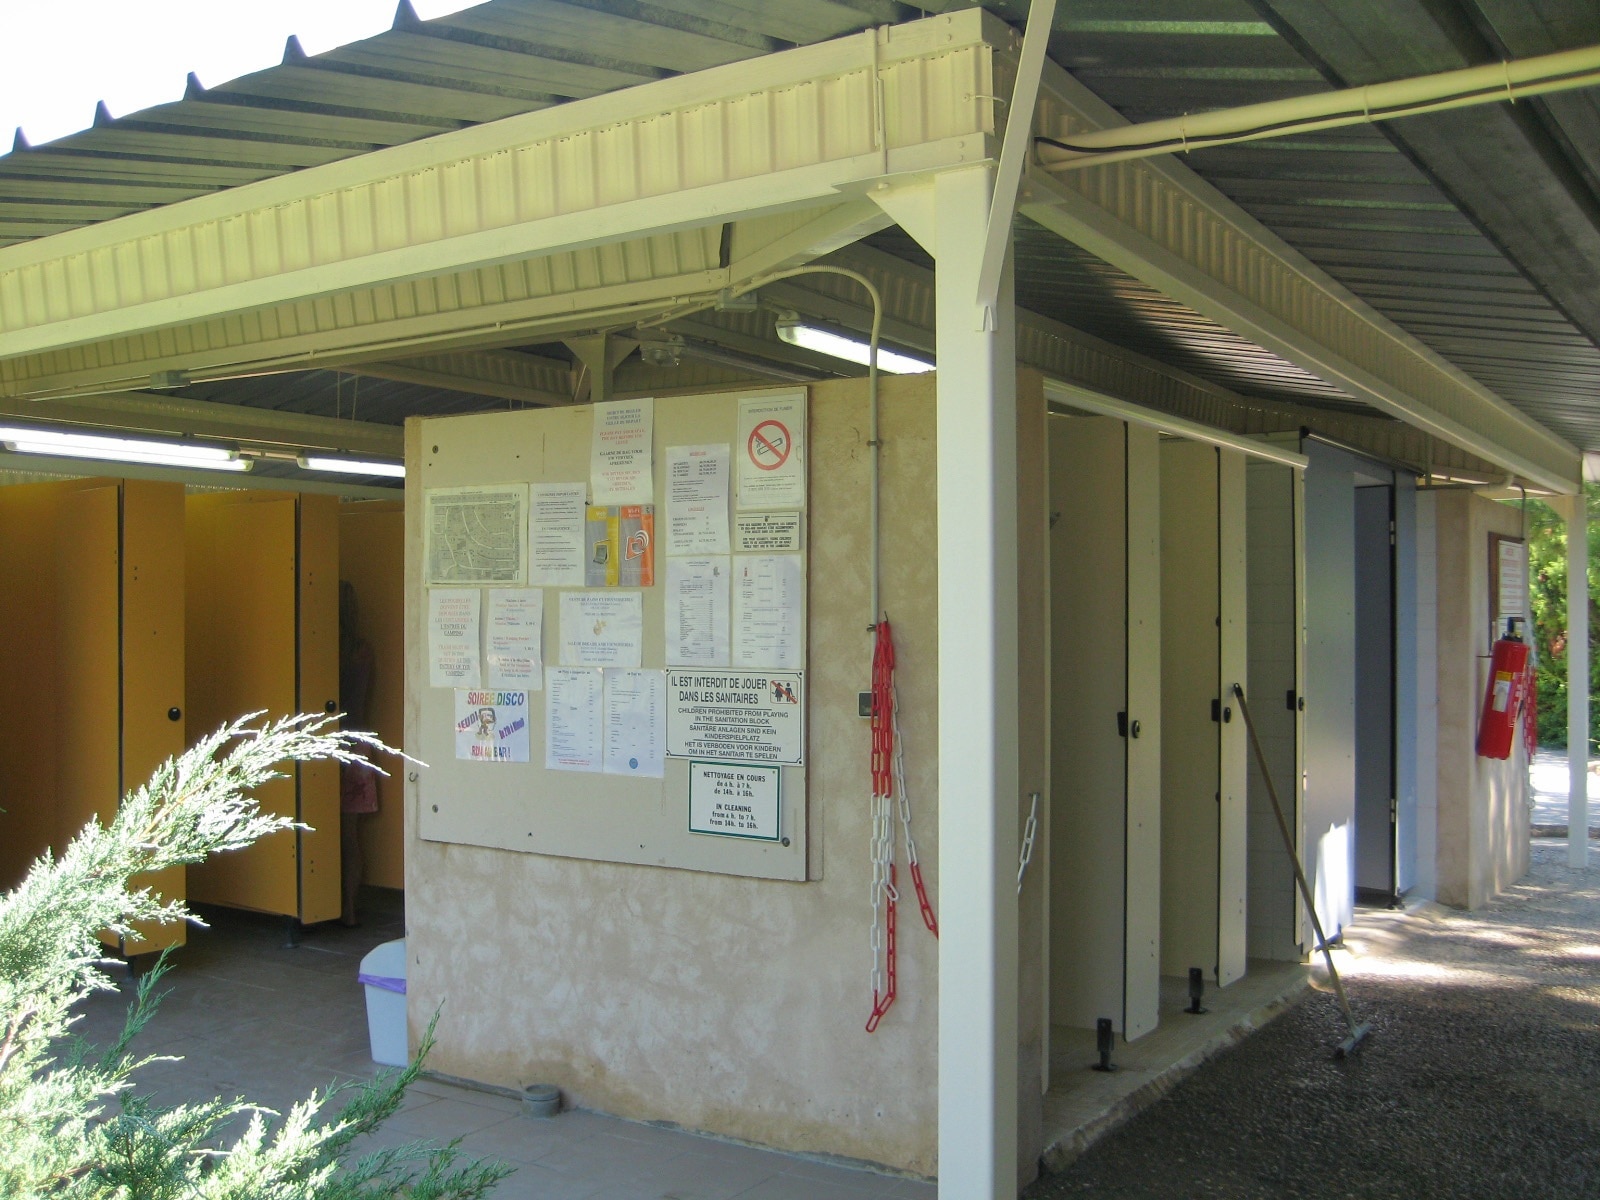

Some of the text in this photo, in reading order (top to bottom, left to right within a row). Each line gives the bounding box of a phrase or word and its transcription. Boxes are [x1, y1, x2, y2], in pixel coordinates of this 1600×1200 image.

[672, 677, 767, 690] IL EST INTERDIT DE JOUER
[468, 692, 524, 706] SOIREE DISCO
[680, 691, 758, 704] DANS LES SANITAIRES
[704, 772, 734, 780] NETTOYAGE
[725, 804, 751, 812] CLEANING
